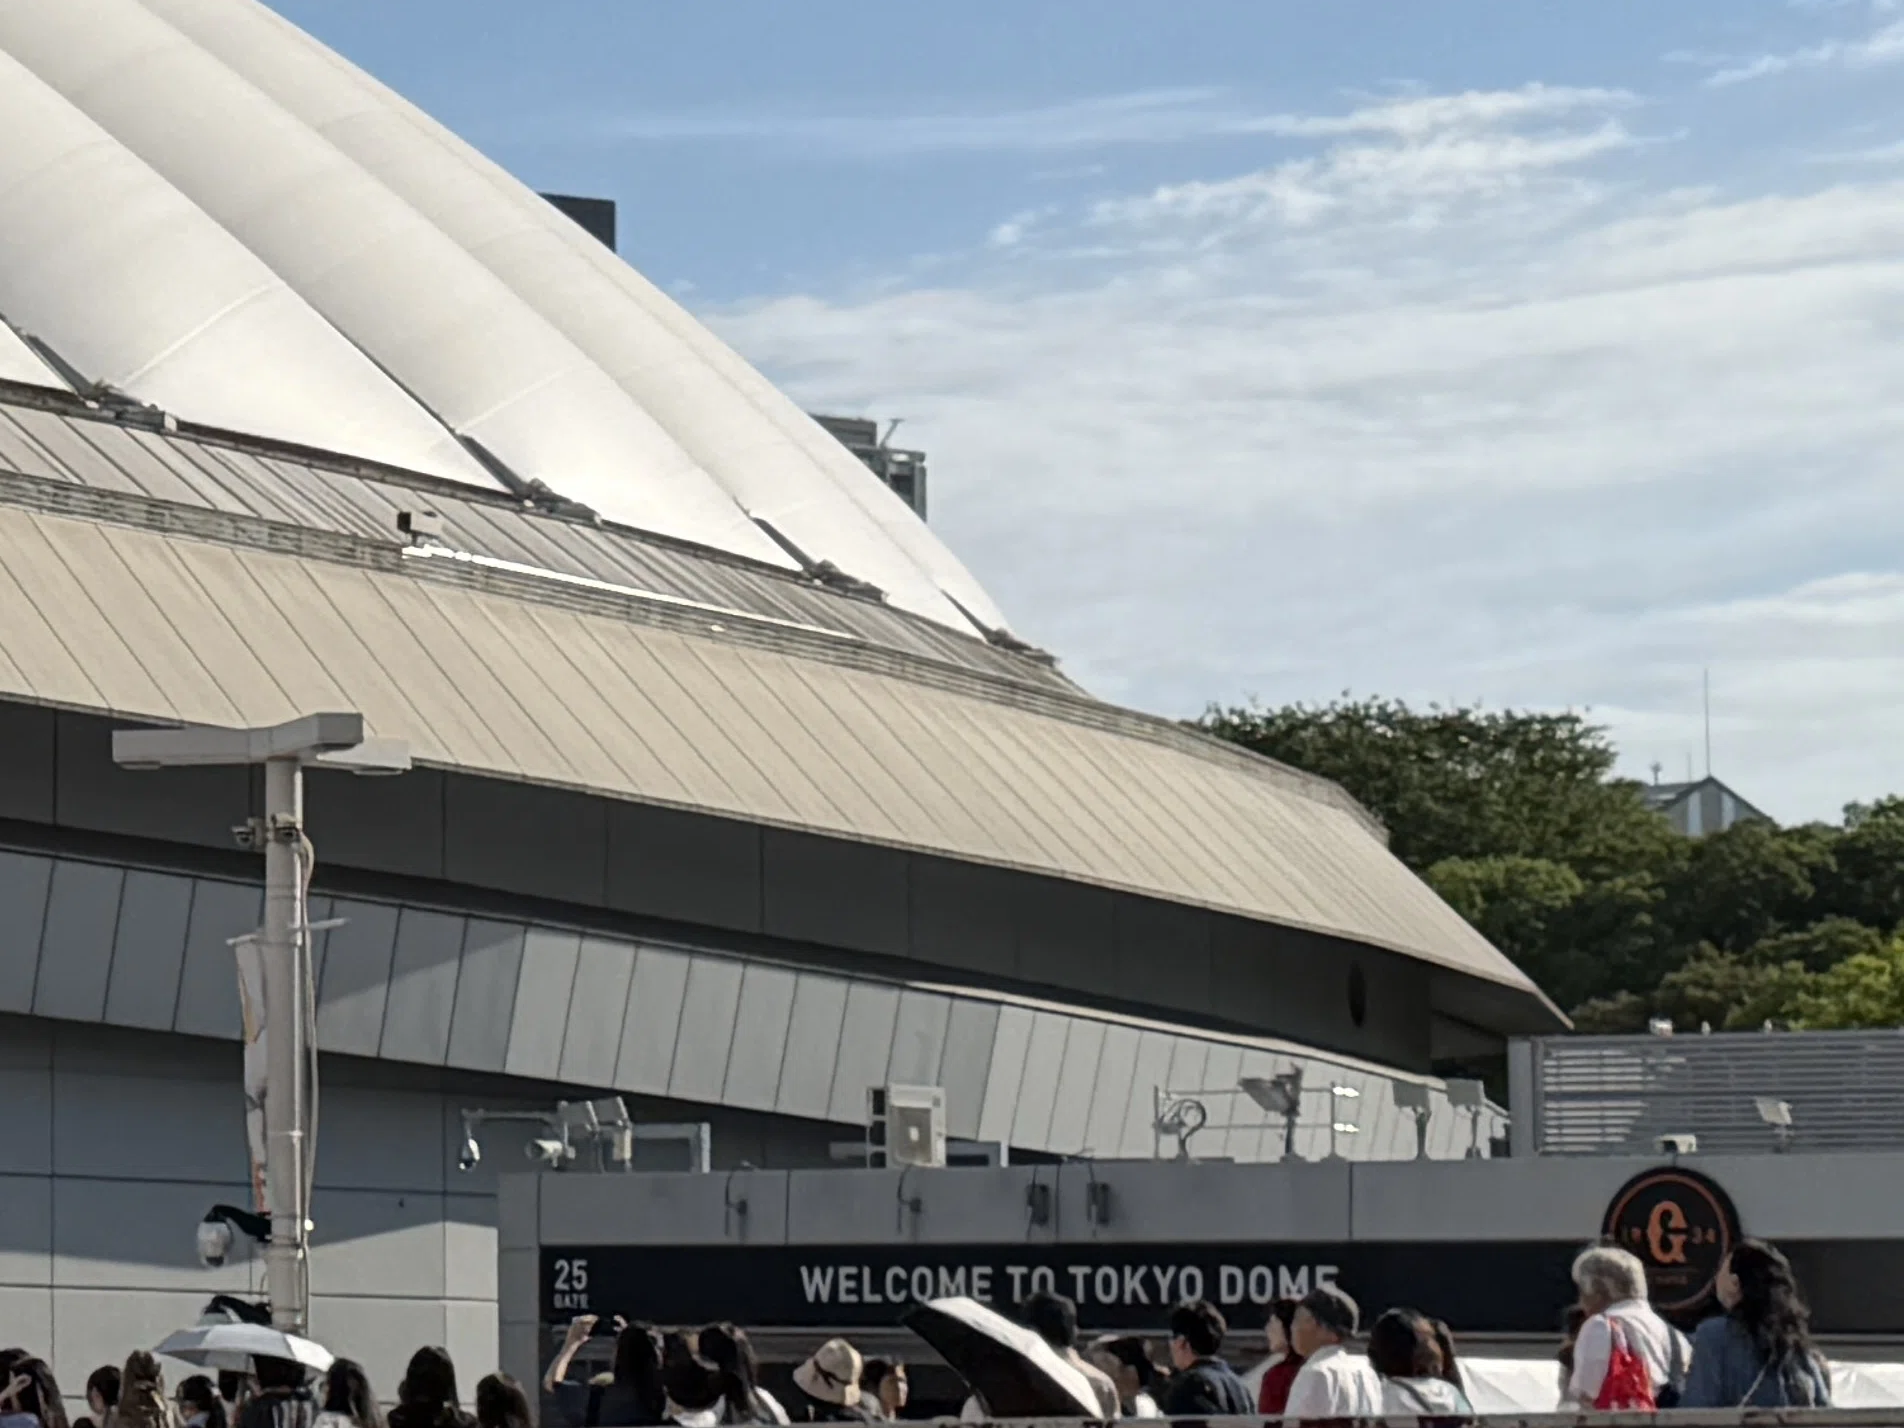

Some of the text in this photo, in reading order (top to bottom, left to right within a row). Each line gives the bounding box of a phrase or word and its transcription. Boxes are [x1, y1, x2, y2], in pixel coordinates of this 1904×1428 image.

[1647, 1200, 1688, 1263] G
[554, 1258, 589, 1291] 25
[800, 1265, 993, 1303] WELCOME
[1005, 1265, 1056, 1304] TO
[1068, 1265, 1204, 1304] TOKYO
